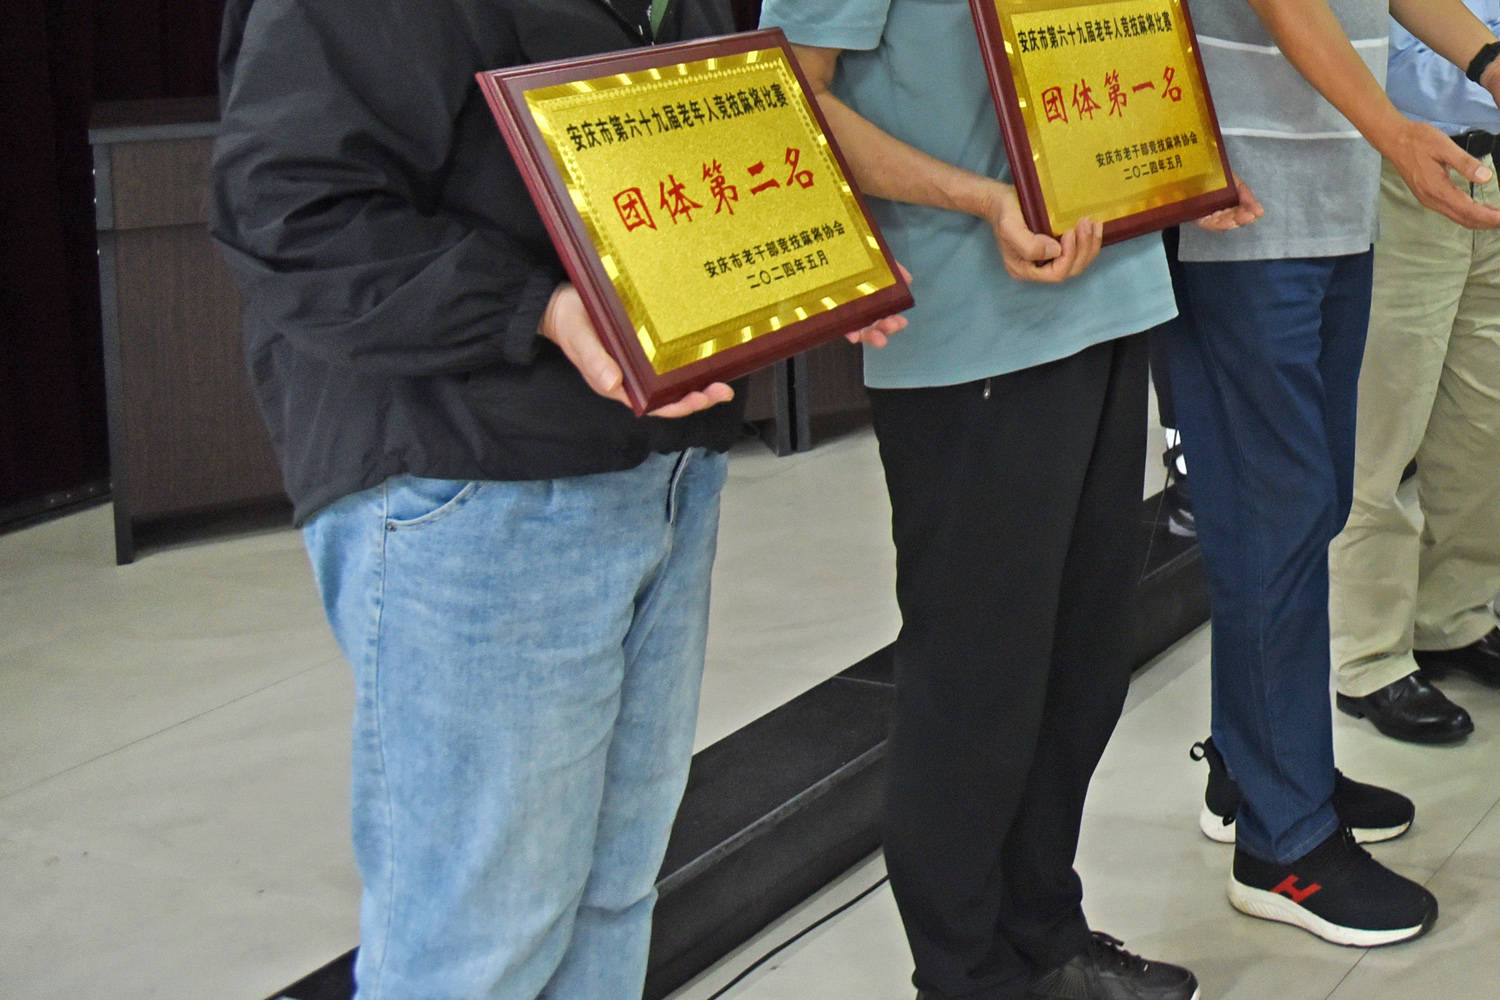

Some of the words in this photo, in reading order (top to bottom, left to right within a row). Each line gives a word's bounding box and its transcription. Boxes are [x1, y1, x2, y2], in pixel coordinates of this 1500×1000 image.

[1017, 11, 1173, 53] 安庆市第六十九届老年人竞技麻将比赛
[566, 83, 790, 152] 安庆市第六十九届老年人竞技麻将比赛
[1041, 66, 1182, 124] 团体第一名
[1096, 131, 1198, 168] 安庆市老干部竞技麻将协会
[613, 147, 815, 233] 团体第二名
[704, 220, 847, 278] 安庆市老干部竞技麻将协会
